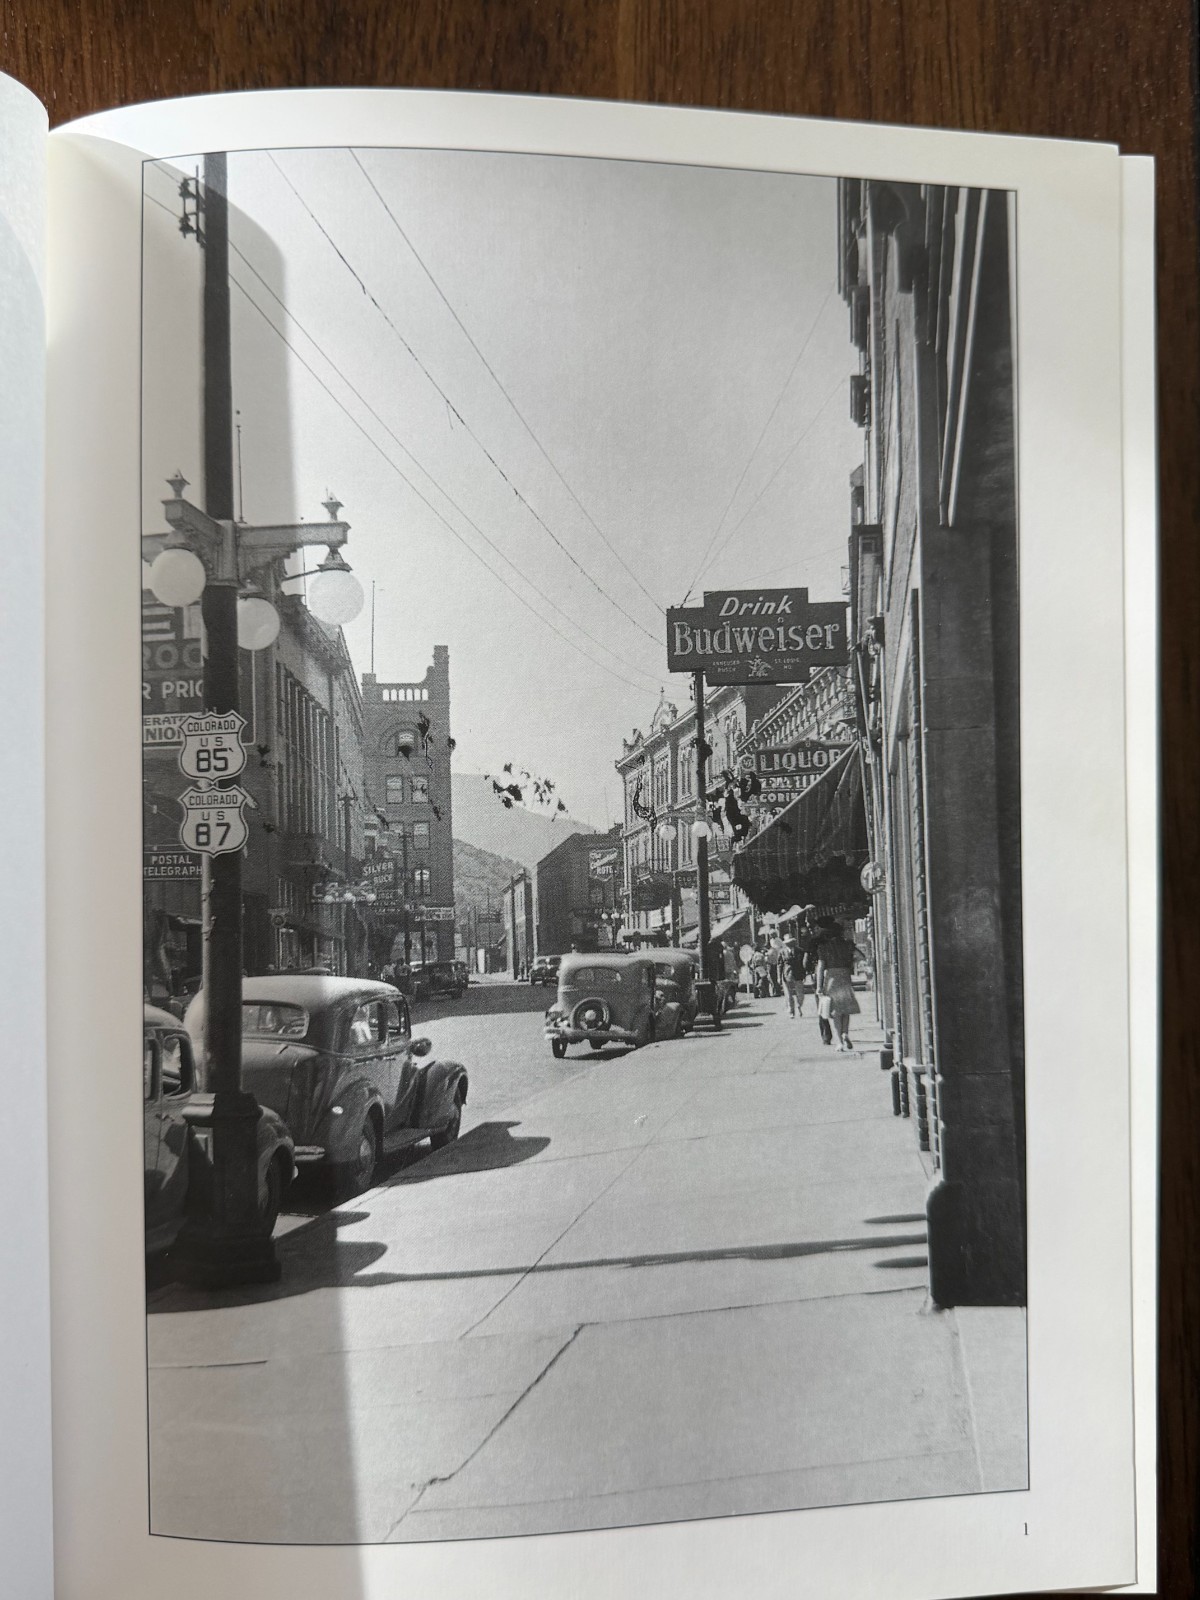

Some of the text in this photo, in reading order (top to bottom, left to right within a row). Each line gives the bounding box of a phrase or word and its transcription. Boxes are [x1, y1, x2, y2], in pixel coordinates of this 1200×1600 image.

[719, 595, 793, 617] Drink
[673, 616, 840, 656] Budweiser
[187, 719, 236, 732] COLORADO
[196, 747, 229, 773] 85
[189, 794, 238, 806] COLORADO
[195, 822, 231, 846] 87
[151, 854, 192, 865] POSTAL
[143, 865, 203, 876] TELEGRAPH
[362, 861, 394, 876] SILVER
[1023, 1521, 1029, 1536] 1
